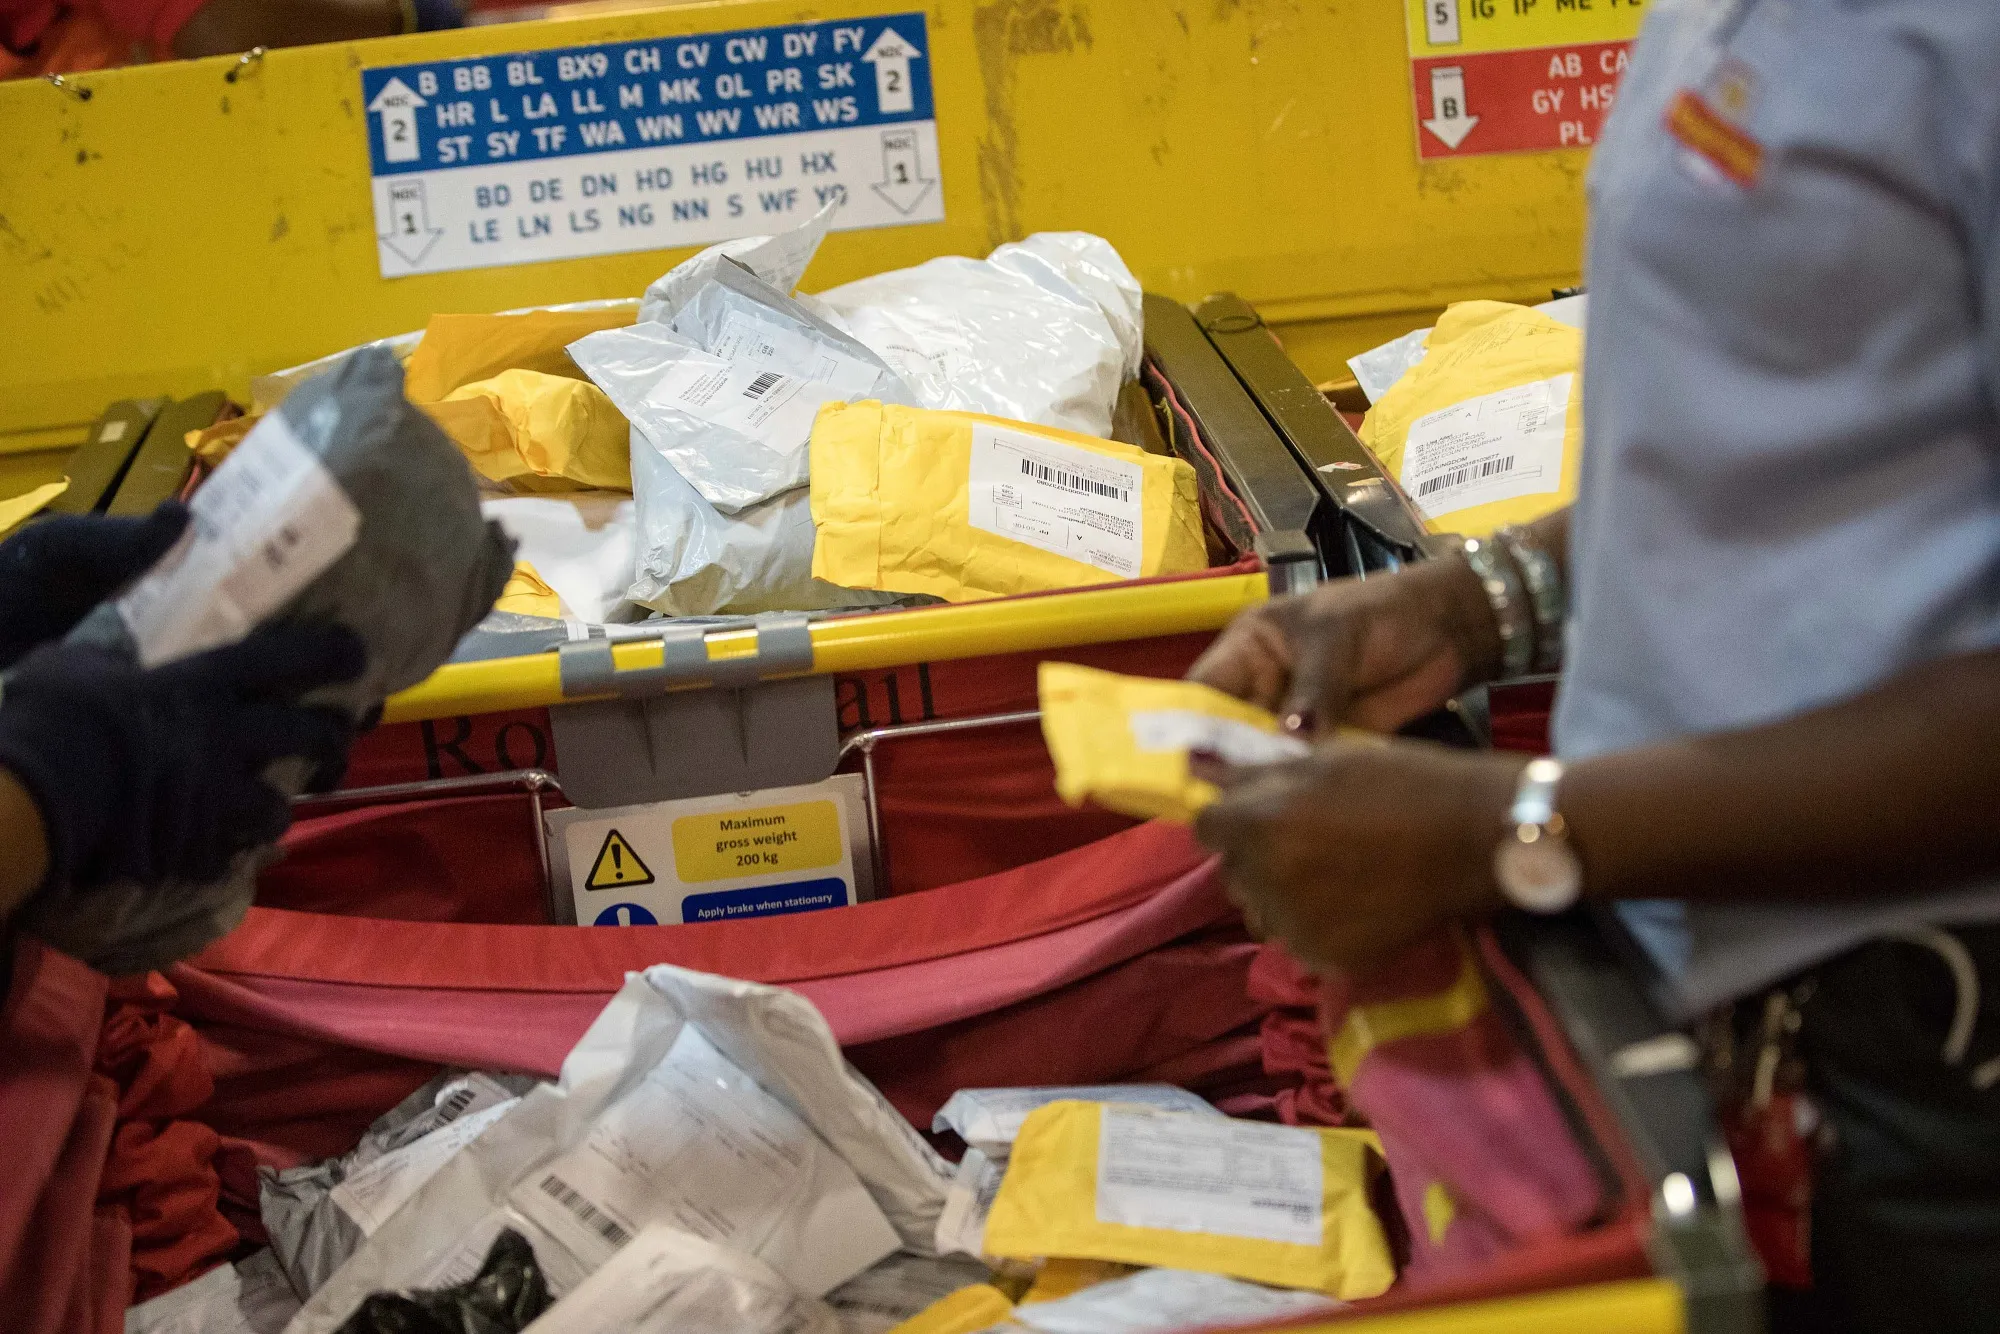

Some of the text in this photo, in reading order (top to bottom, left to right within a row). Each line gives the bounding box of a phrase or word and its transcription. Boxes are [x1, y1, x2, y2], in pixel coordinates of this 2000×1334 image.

[1435, 3, 1448, 25] 5
[418, 26, 865, 96] B BB BL BX9 CH CV CW DY FY
[1549, 49, 1630, 79] AB CA
[885, 70, 900, 93] 2
[436, 62, 855, 128] HR L LA LL M MK OL PR SK
[1532, 84, 1615, 114] GY HS
[1442, 97, 1458, 119] B
[391, 119, 406, 141] 2
[437, 96, 859, 163] ST SY TF WA WN WV WR WS
[1559, 120, 1592, 145] PL
[475, 151, 836, 208] BD DE DN HD HG HU HX
[894, 163, 909, 183] 1
[403, 212, 417, 234] 1
[469, 219, 501, 243] LE
[518, 213, 552, 238] LN
[569, 208, 601, 233] LS
[618, 203, 654, 227] NG
[673, 198, 709, 221] NN
[727, 195, 743, 217] S
[758, 188, 797, 213] WF
[1434, 456, 1468, 469] KINGDOM
[834, 662, 944, 732] ail
[719, 814, 786, 831] Maximum
[715, 831, 798, 852] gross weight
[736, 851, 778, 867] 200 kg
[697, 893, 833, 918] Apply brake when stationary
